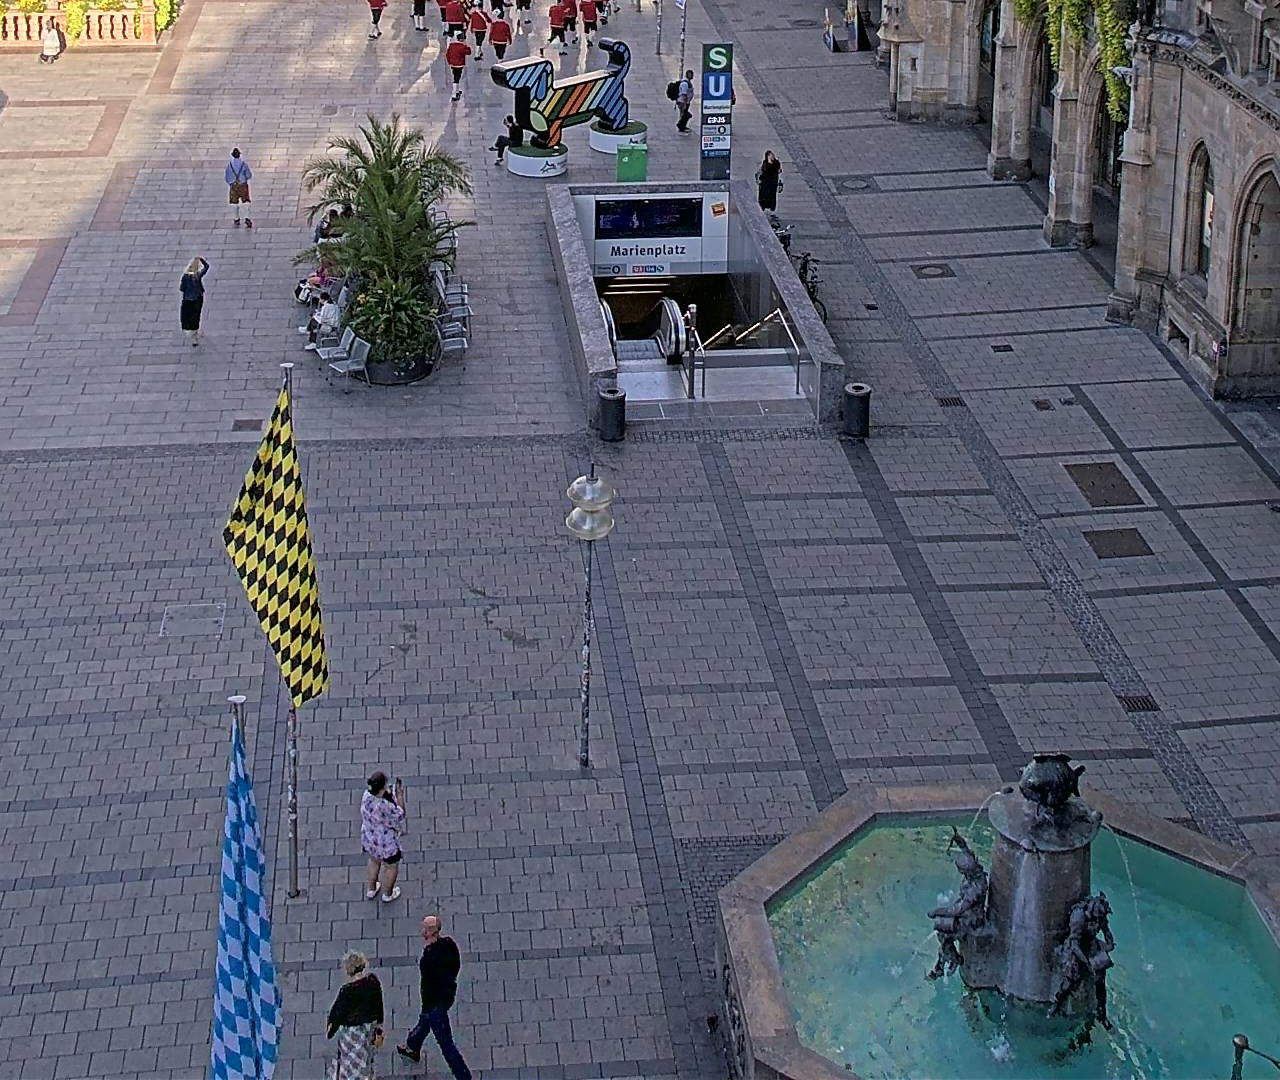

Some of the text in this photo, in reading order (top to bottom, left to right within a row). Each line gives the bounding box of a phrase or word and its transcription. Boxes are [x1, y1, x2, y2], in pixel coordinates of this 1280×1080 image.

[709, 47, 727, 69] S
[708, 75, 726, 97] U
[611, 245, 686, 258] Marienplatz
